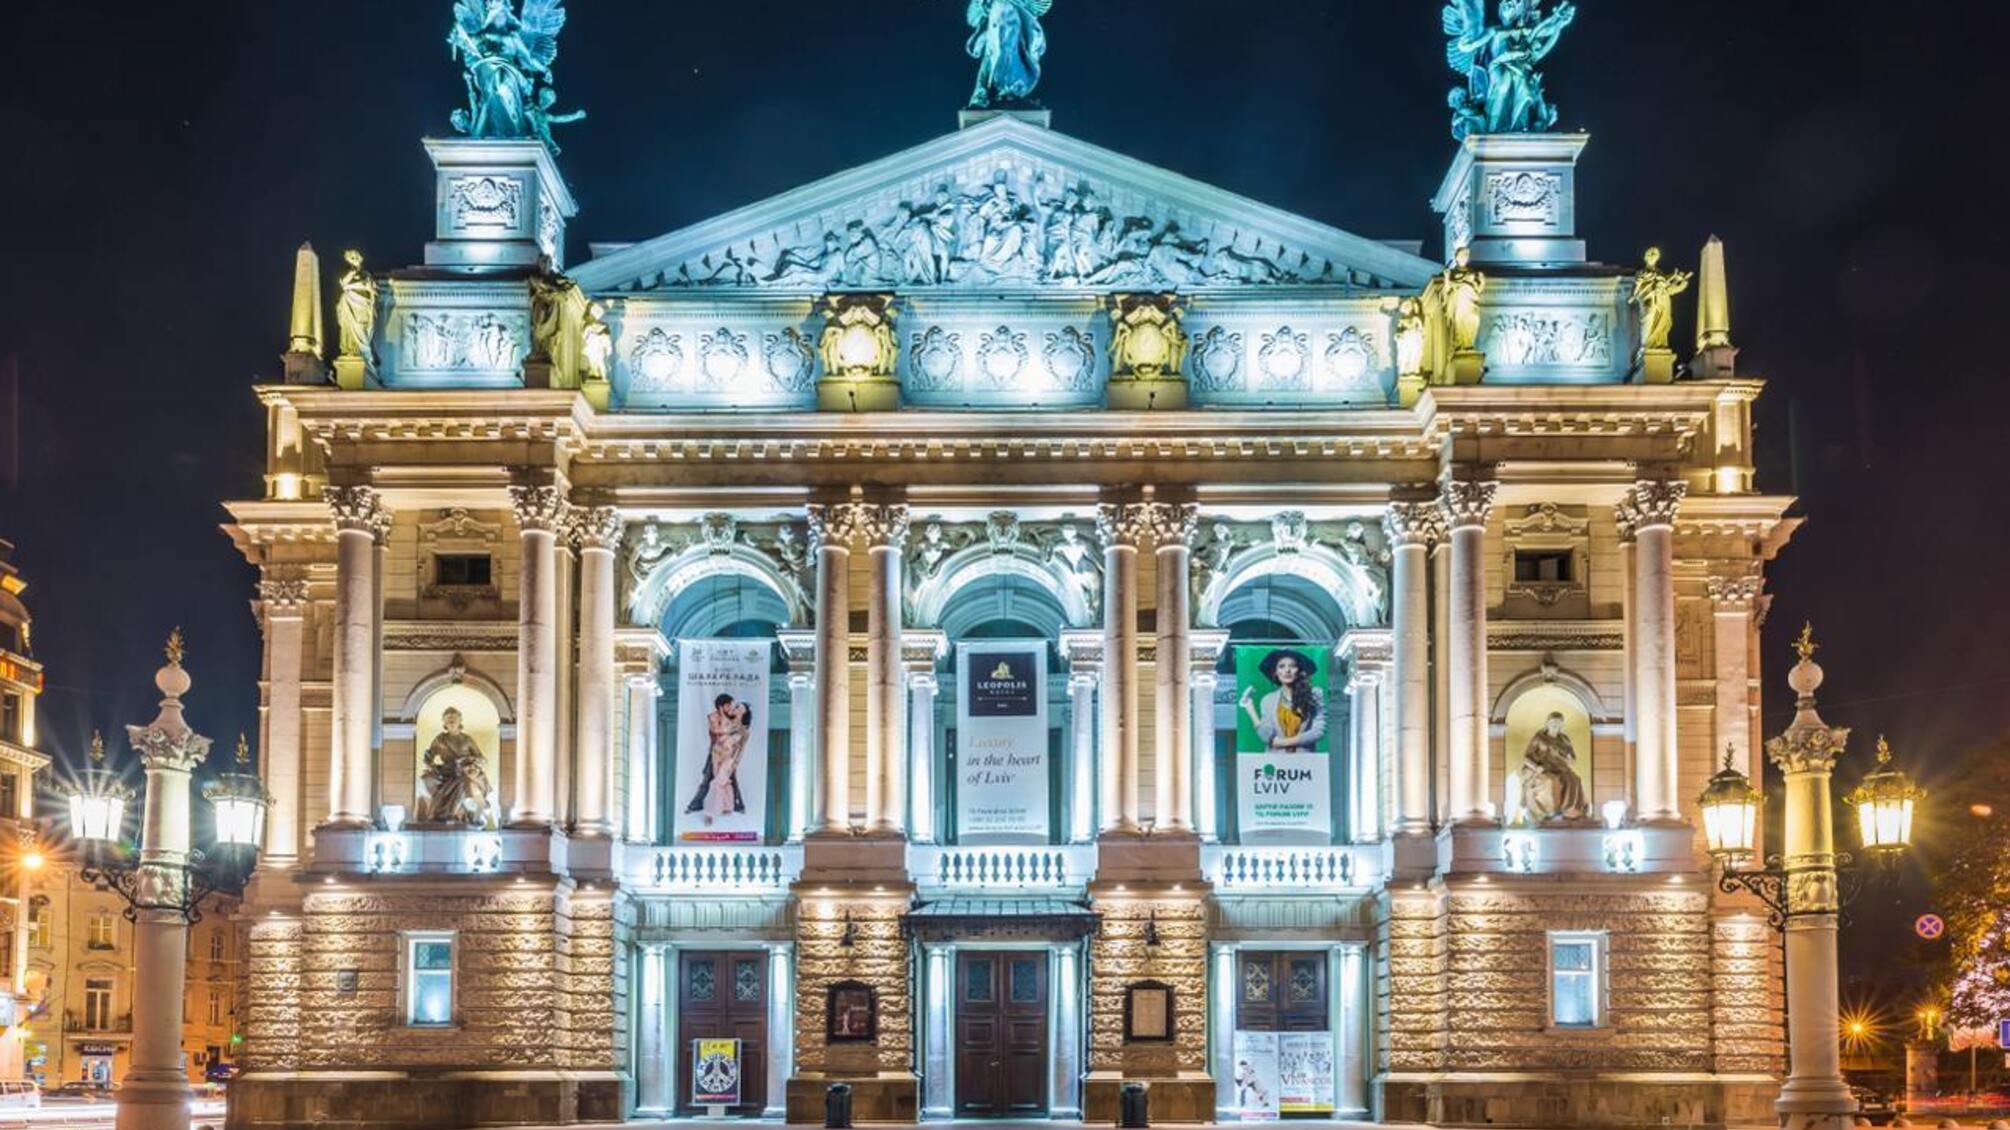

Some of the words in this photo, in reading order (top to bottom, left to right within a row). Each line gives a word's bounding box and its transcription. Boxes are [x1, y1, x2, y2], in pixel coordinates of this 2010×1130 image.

[977, 681, 1027, 689] LEOPOLIS
[969, 735, 1015, 751] Luxury
[966, 753, 980, 766] in
[984, 754, 1004, 766] the
[1007, 752, 1040, 766] heart
[966, 771, 983, 786] of
[985, 771, 1016, 784] Lviv
[1254, 764, 1312, 781] FORUM
[1254, 782, 1290, 794] LVIV
